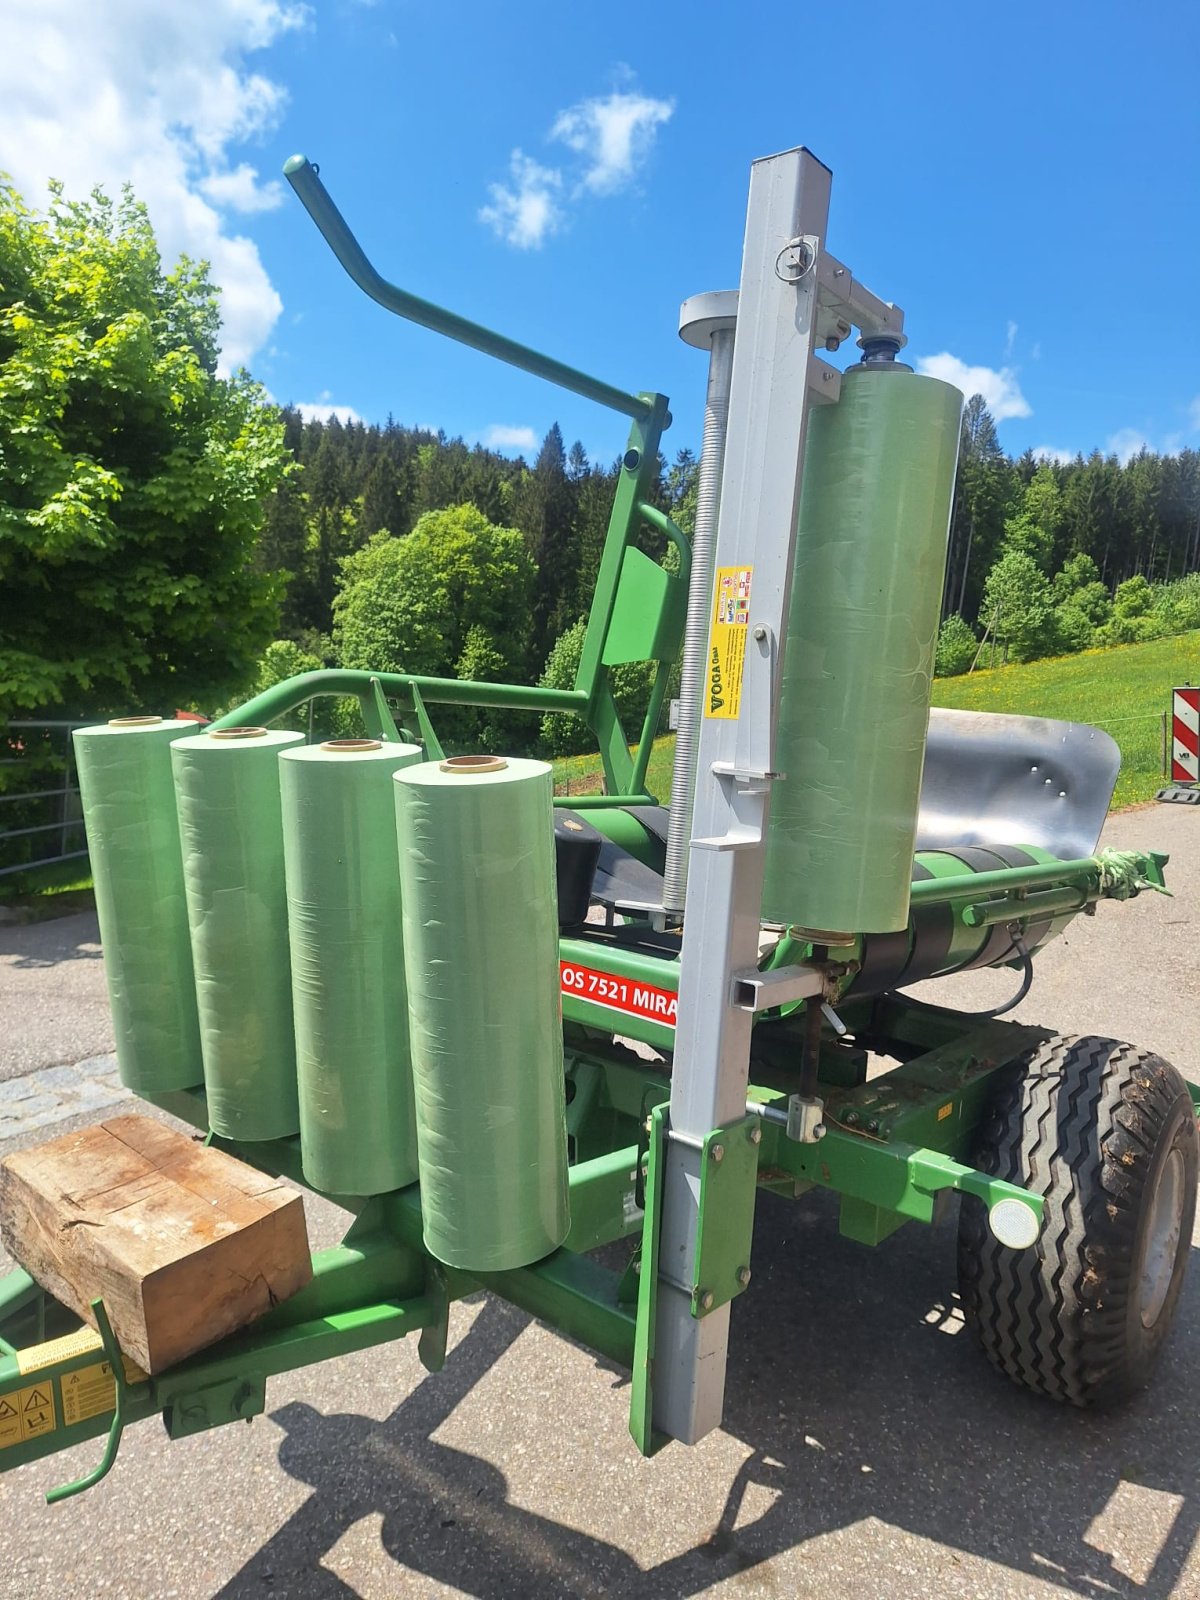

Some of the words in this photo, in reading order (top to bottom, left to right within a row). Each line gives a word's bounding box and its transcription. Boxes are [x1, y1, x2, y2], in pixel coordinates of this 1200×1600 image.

[711, 665, 724, 713] VOGA
[562, 968, 585, 989] OS
[588, 975, 627, 1002] 7521
[633, 988, 678, 1017] MIRA
